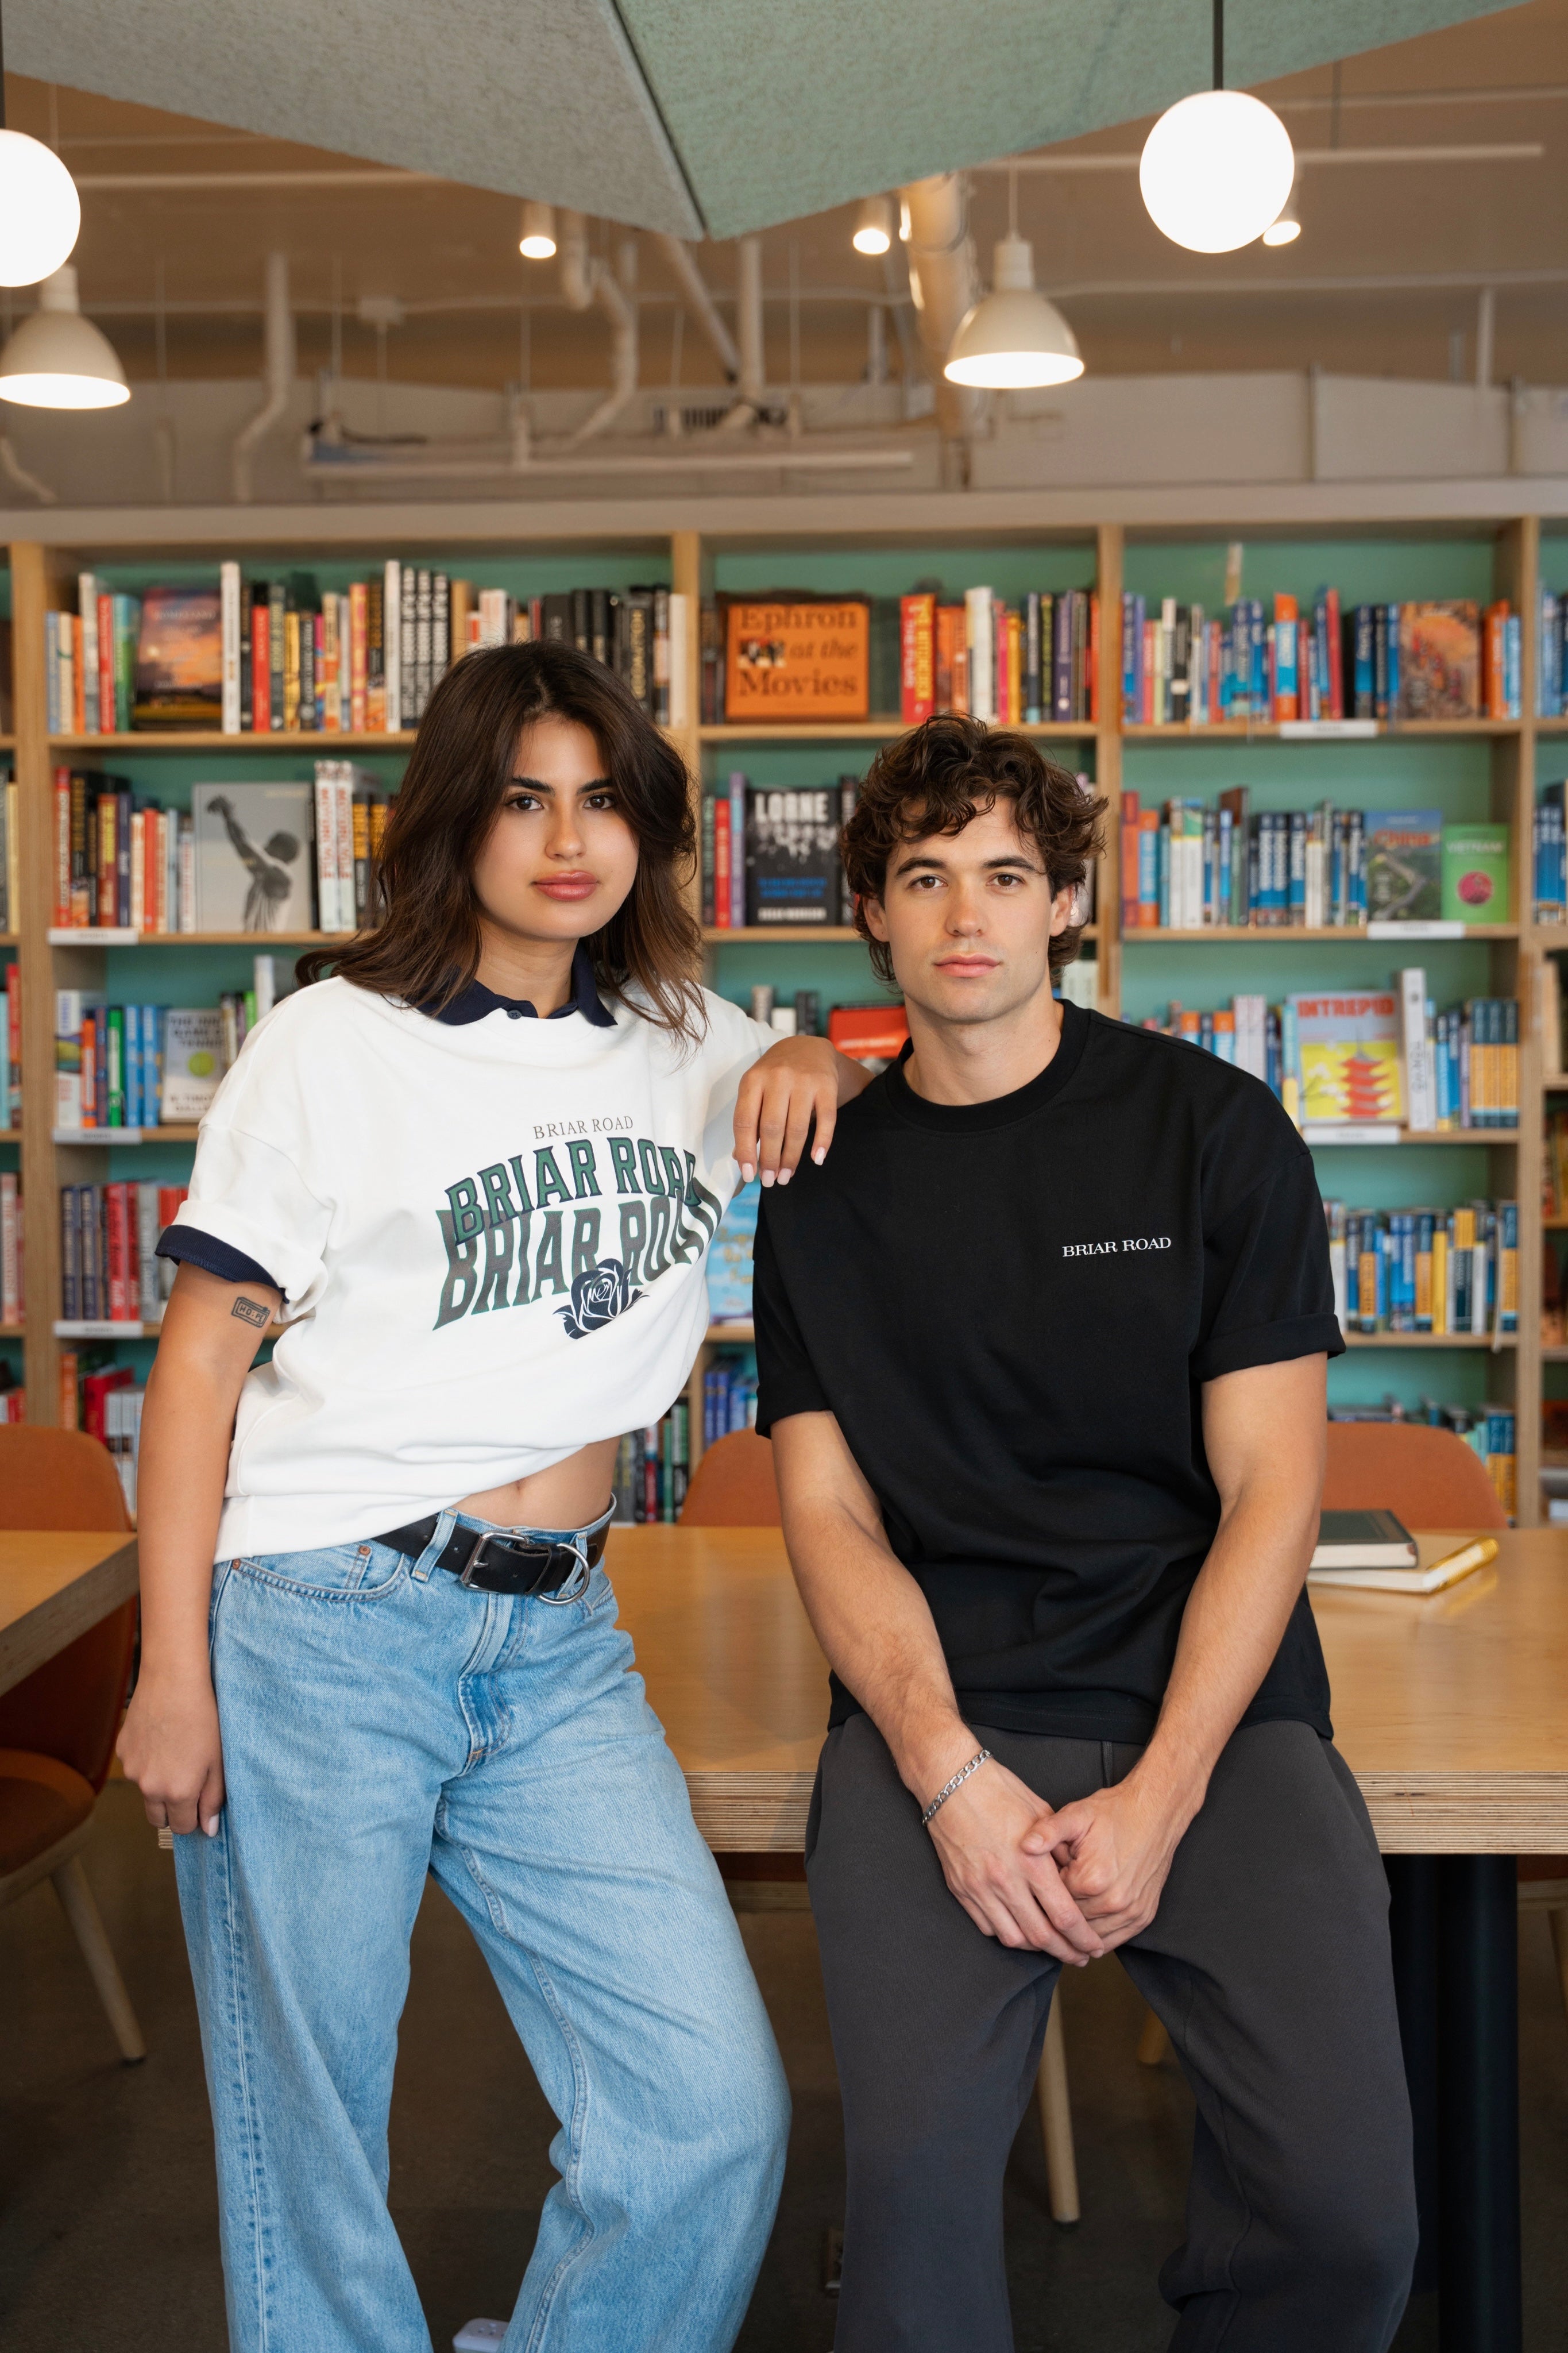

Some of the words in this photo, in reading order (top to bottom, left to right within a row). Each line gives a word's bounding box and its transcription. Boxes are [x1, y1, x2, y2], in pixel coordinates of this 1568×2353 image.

[740, 607, 858, 633] Ephron
[789, 639, 814, 659] at
[820, 638, 858, 659] the
[739, 668, 858, 697] Movies
[755, 792, 829, 824] LORNE
[1373, 828, 1431, 847] China
[1445, 839, 1503, 854] VIETNAM
[1296, 997, 1395, 1019] INTREPID
[533, 1120, 588, 1139] BRIAR
[592, 1116, 633, 1132] ROAD
[445, 1139, 603, 1247] BRIAR
[607, 1137, 702, 1206] ROAD
[1062, 1241, 1118, 1257] BRIAR
[1122, 1237, 1171, 1251] ROAD
[432, 1206, 601, 1331] BRIAR
